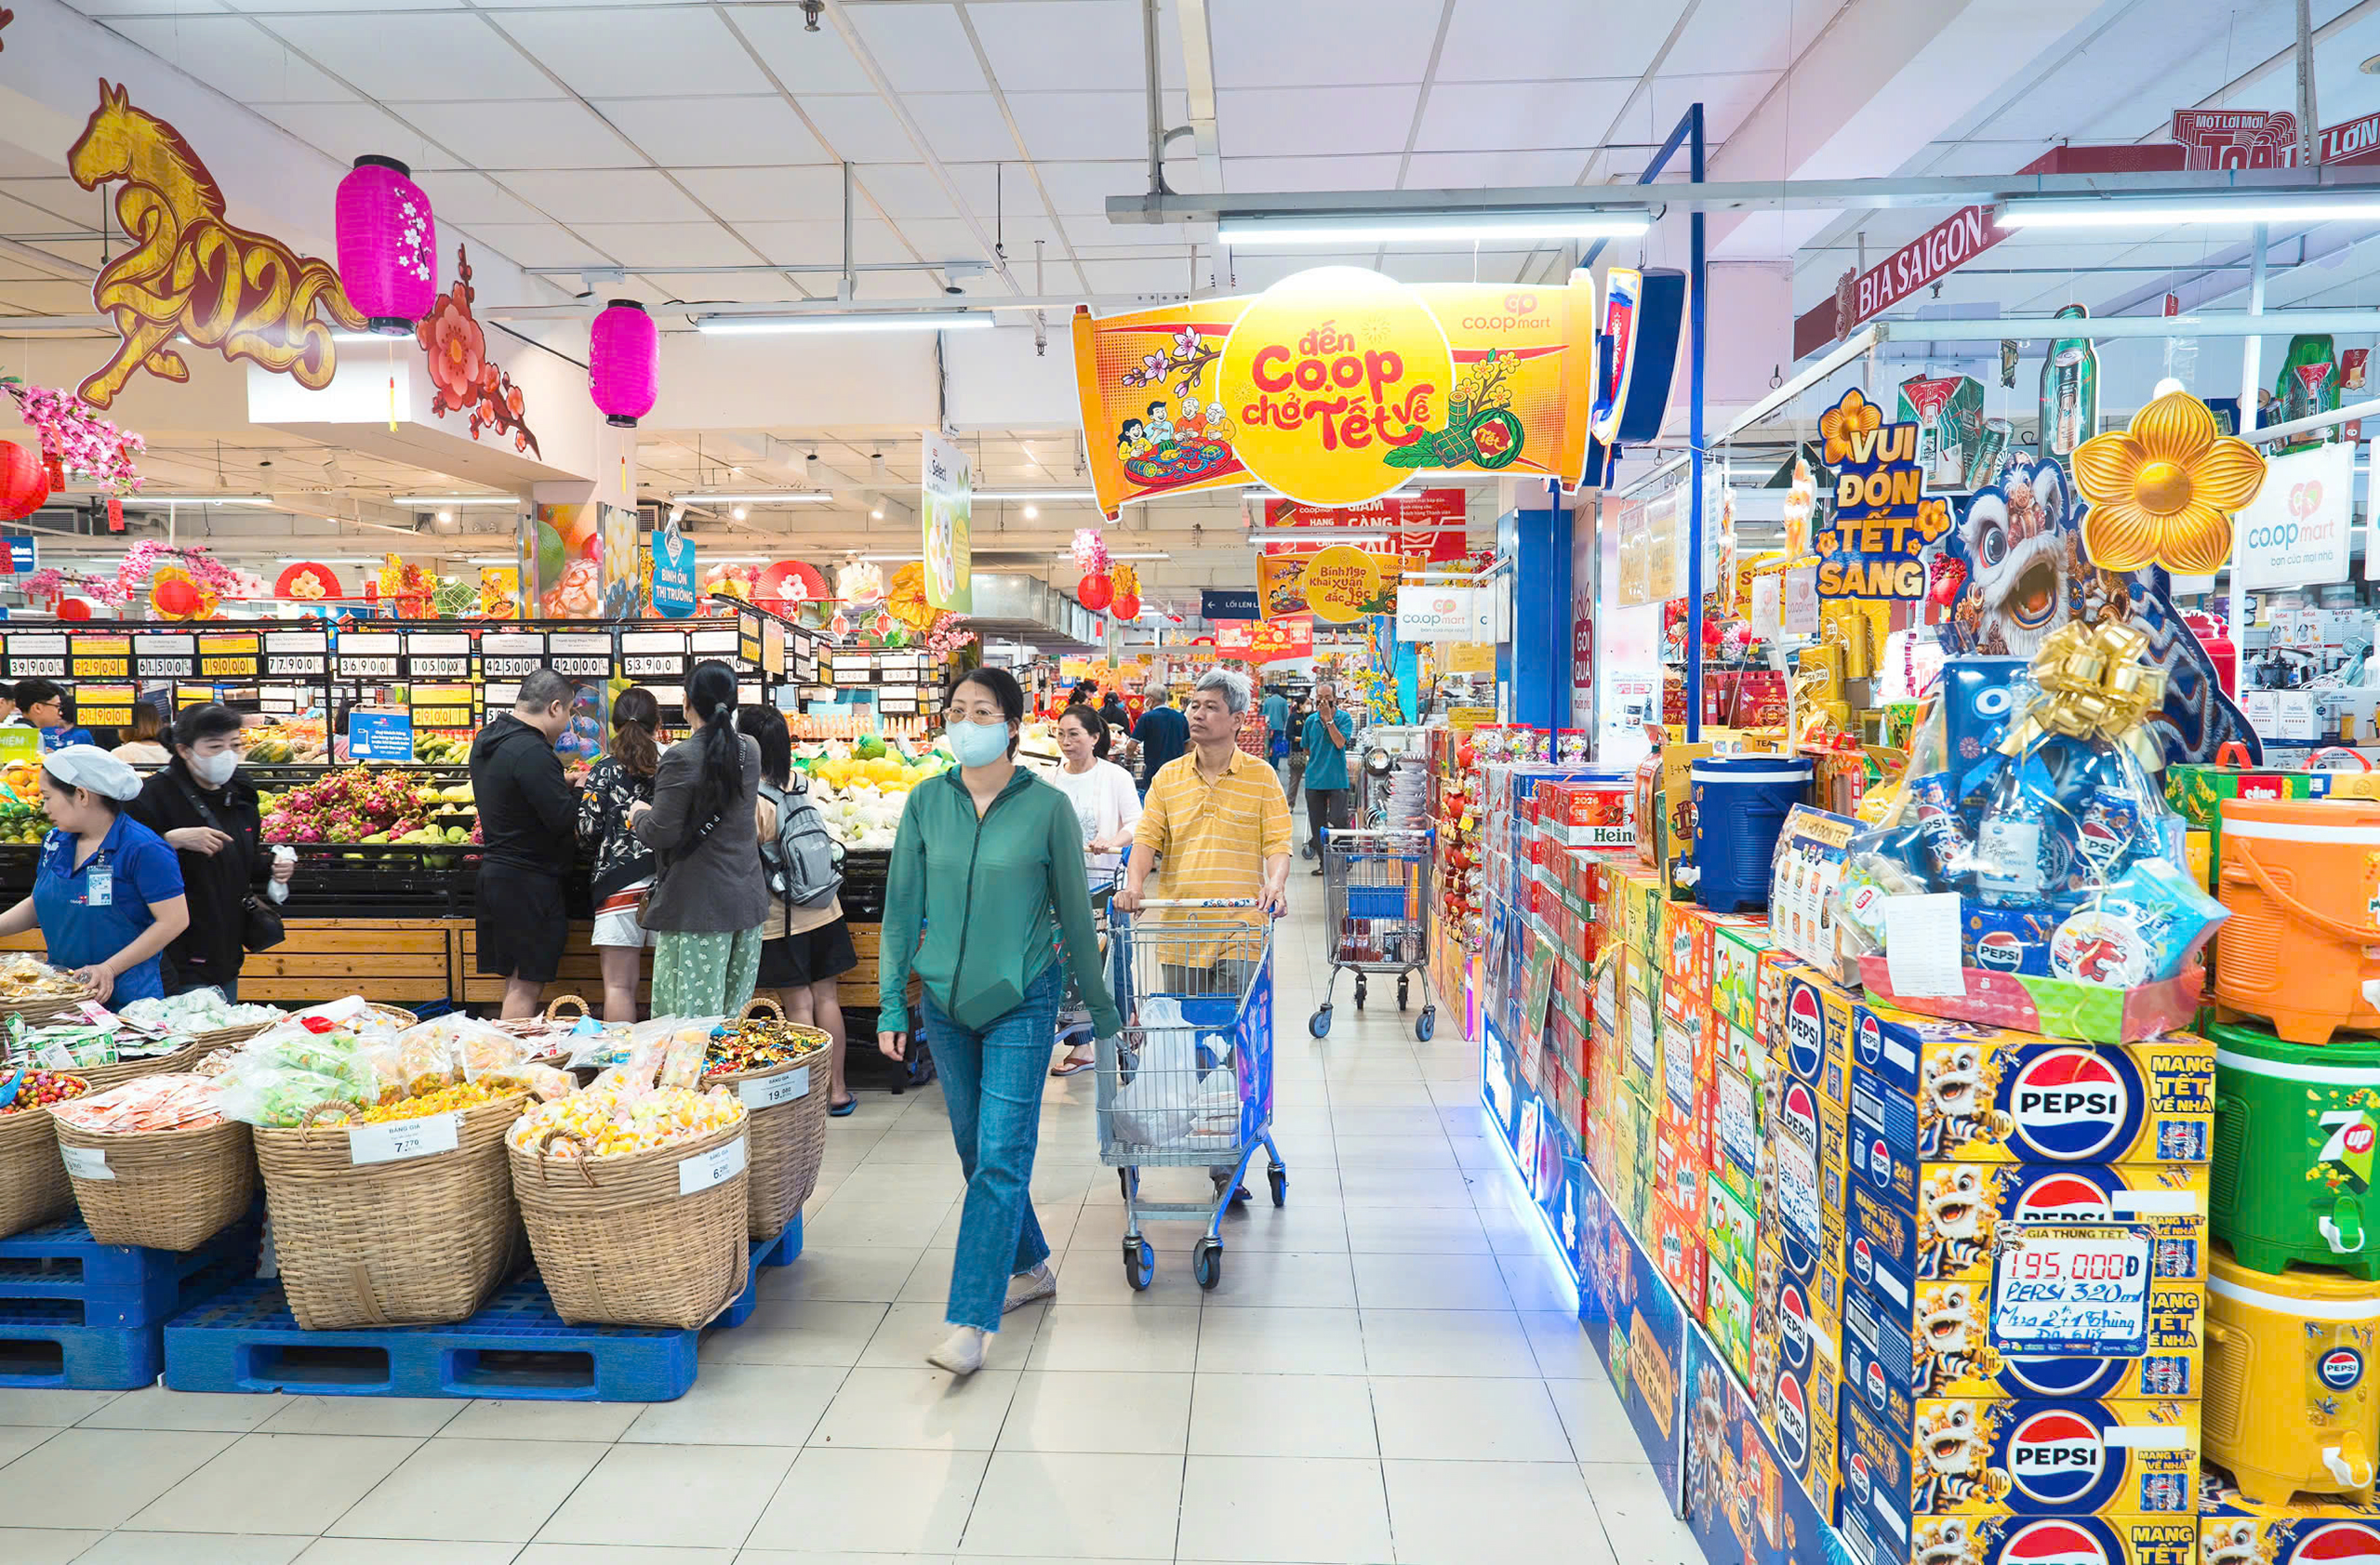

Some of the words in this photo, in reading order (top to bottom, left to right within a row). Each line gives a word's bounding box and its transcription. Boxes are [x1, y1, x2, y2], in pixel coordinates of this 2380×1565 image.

[2330, 117, 2379, 157] LỚN
[1858, 270, 1894, 320] BIA
[1896, 205, 1982, 295] SAIGON
[1298, 319, 1356, 354] đến
[1243, 388, 1301, 429] chở
[1305, 397, 1422, 450] Tết
[1477, 427, 1509, 451] Tết
[1848, 426, 1915, 464] VUI
[1837, 471, 1920, 508] ĐÓN
[1836, 510, 1914, 553] TẾT
[661, 567, 677, 583] BÌNH
[677, 566, 687, 586] ỔN
[1310, 577, 1331, 586] Khai
[1321, 566, 1345, 577] Bính
[1346, 566, 1367, 579] Ngọ
[1816, 562, 1923, 597] SANG
[656, 585, 667, 602] THỊ
[668, 587, 694, 603] TRƯỜNG
[1324, 590, 1345, 602] đắc
[1344, 588, 1371, 606] Lộc
[1576, 626, 1590, 652] GÓI
[11, 661, 54, 674] 39.900
[74, 661, 117, 674] 92.900
[140, 661, 181, 673] 61.500
[204, 660, 246, 672] 19.000
[269, 658, 312, 670] 77.900
[342, 661, 387, 673] 36.900
[413, 661, 459, 673] 105.000
[627, 658, 672, 671] 53.900
[1575, 654, 1591, 682] QUÀ
[79, 711, 122, 723] 61.900
[1756, 739, 1773, 748] TEA
[1574, 797, 1600, 805] 2026
[1980, 945, 2019, 962] PEPSI
[1791, 1015, 1818, 1048] PEPSI
[1862, 1030, 1879, 1049] PEPSI
[2151, 1056, 2215, 1072] MANG
[2156, 1071, 2210, 1095] TẾT
[2021, 1092, 2117, 1114] PEPSI
[2151, 1095, 2174, 1113] VỀ
[2176, 1097, 2213, 1113] NHÀ
[1787, 1110, 1814, 1149] PEPSI
[1872, 1154, 1889, 1173] PEPSI
[2182, 1213, 2205, 1226] TẾT
[2172, 1225, 2197, 1236] NHÀ
[1854, 1249, 1871, 1274] PEPSI
[2151, 1292, 2200, 1309] ANG
[1782, 1306, 1805, 1346] PEPSI
[2161, 1333, 2198, 1347] NHÀ
[1637, 1325, 1650, 1361] VUI
[1651, 1355, 1667, 1394] ĐÓN
[2325, 1363, 2357, 1373] PEPSI
[1633, 1347, 1647, 1386] TẾT
[1647, 1375, 1669, 1431] SANG
[1868, 1373, 1885, 1399] PEPSI
[1778, 1396, 1804, 1444] PEPSI
[2015, 1447, 2097, 1466] PEPSI
[2138, 1451, 2175, 1461] MANG
[2176, 1448, 2196, 1461] TẾT
[2147, 1460, 2161, 1471] VỀ
[2162, 1459, 2187, 1471] NHÀ
[1851, 1466, 1868, 1493] PEPSI
[2131, 1526, 2195, 1543] MANG
[2136, 1541, 2189, 1565] TẾT
